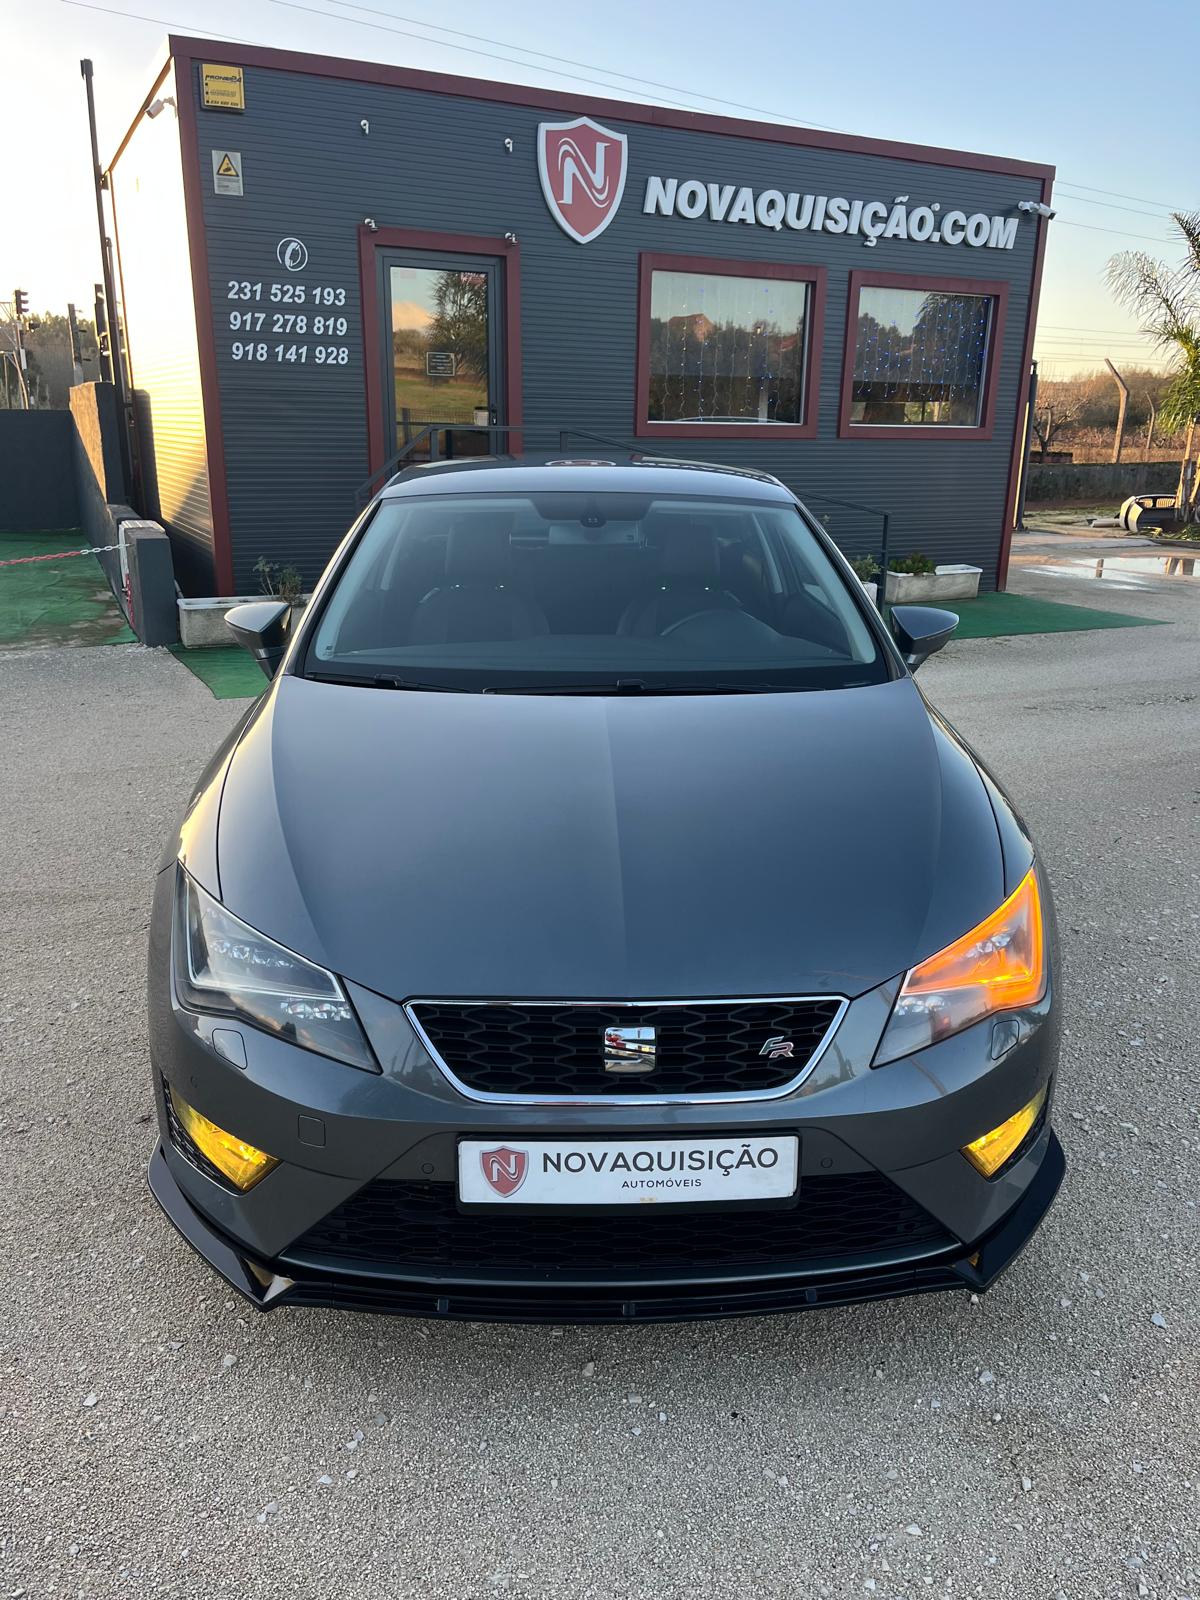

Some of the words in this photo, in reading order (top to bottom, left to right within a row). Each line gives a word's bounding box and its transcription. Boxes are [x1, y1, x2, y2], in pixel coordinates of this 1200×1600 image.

[643, 176, 1019, 249] NOVAQUISIÇÃO.COM
[228, 281, 262, 301] 231
[270, 284, 305, 303] 525
[313, 287, 346, 306] 193
[230, 311, 266, 331] 917
[272, 314, 307, 334] 278
[313, 316, 348, 336] 819
[232, 342, 268, 361] 918
[275, 344, 308, 363] 141
[315, 346, 349, 364] 928
[759, 1036, 794, 1058] FR
[543, 1144, 779, 1177] NOVAQUISIÇÃO
[621, 1177, 702, 1189] AUTOMÓVEIS
